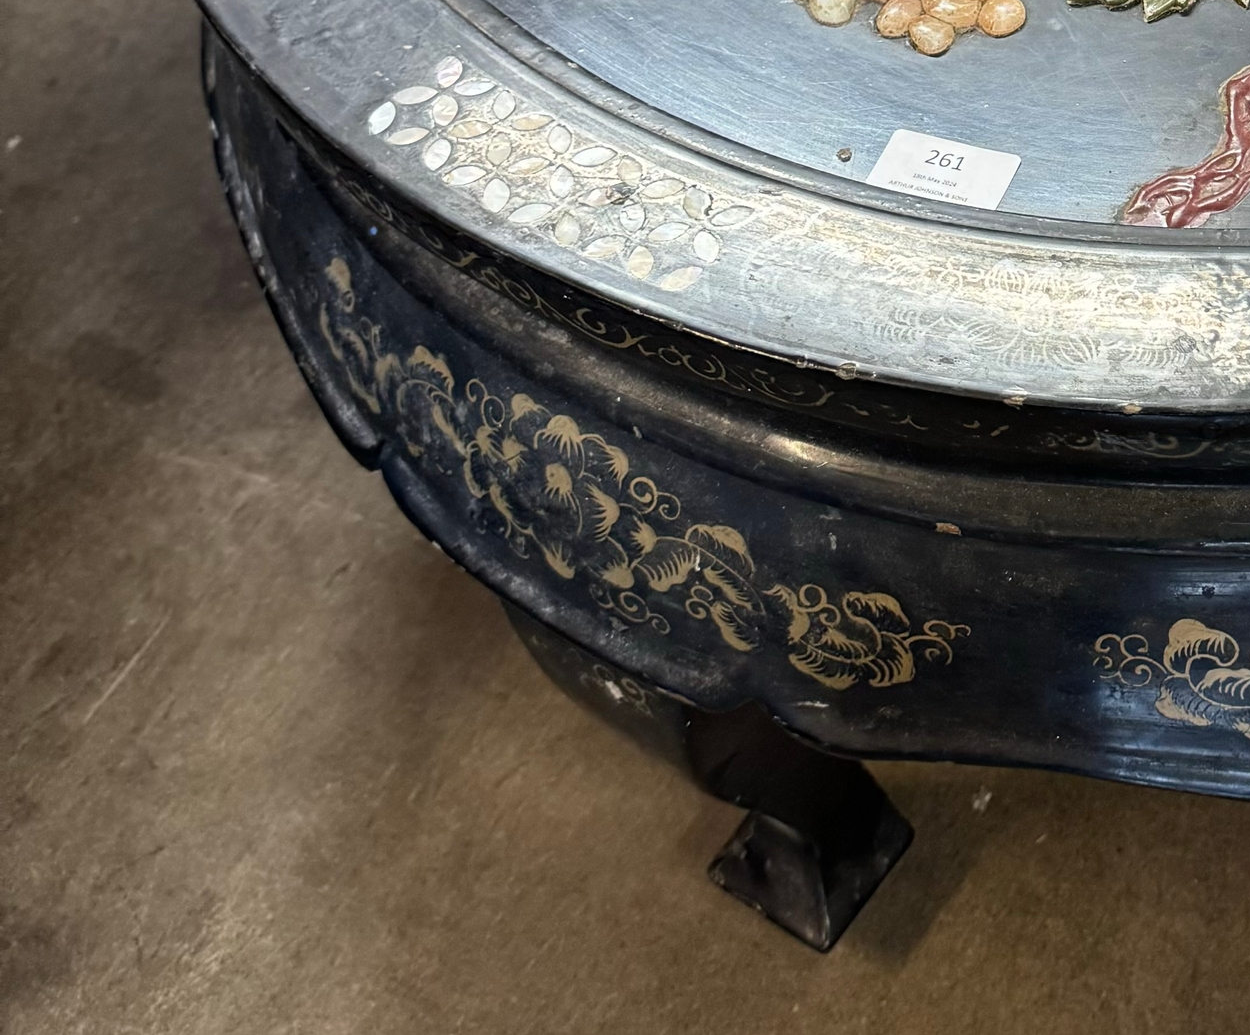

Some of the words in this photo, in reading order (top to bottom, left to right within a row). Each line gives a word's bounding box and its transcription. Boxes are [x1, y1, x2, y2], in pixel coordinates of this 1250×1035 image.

[924, 149, 965, 172] 261
[888, 179, 914, 189] ARTHUR
[914, 186, 944, 196] JOHNSON
[951, 194, 968, 202] SONS
[927, 176, 941, 184] May
[941, 179, 957, 187] 2024
